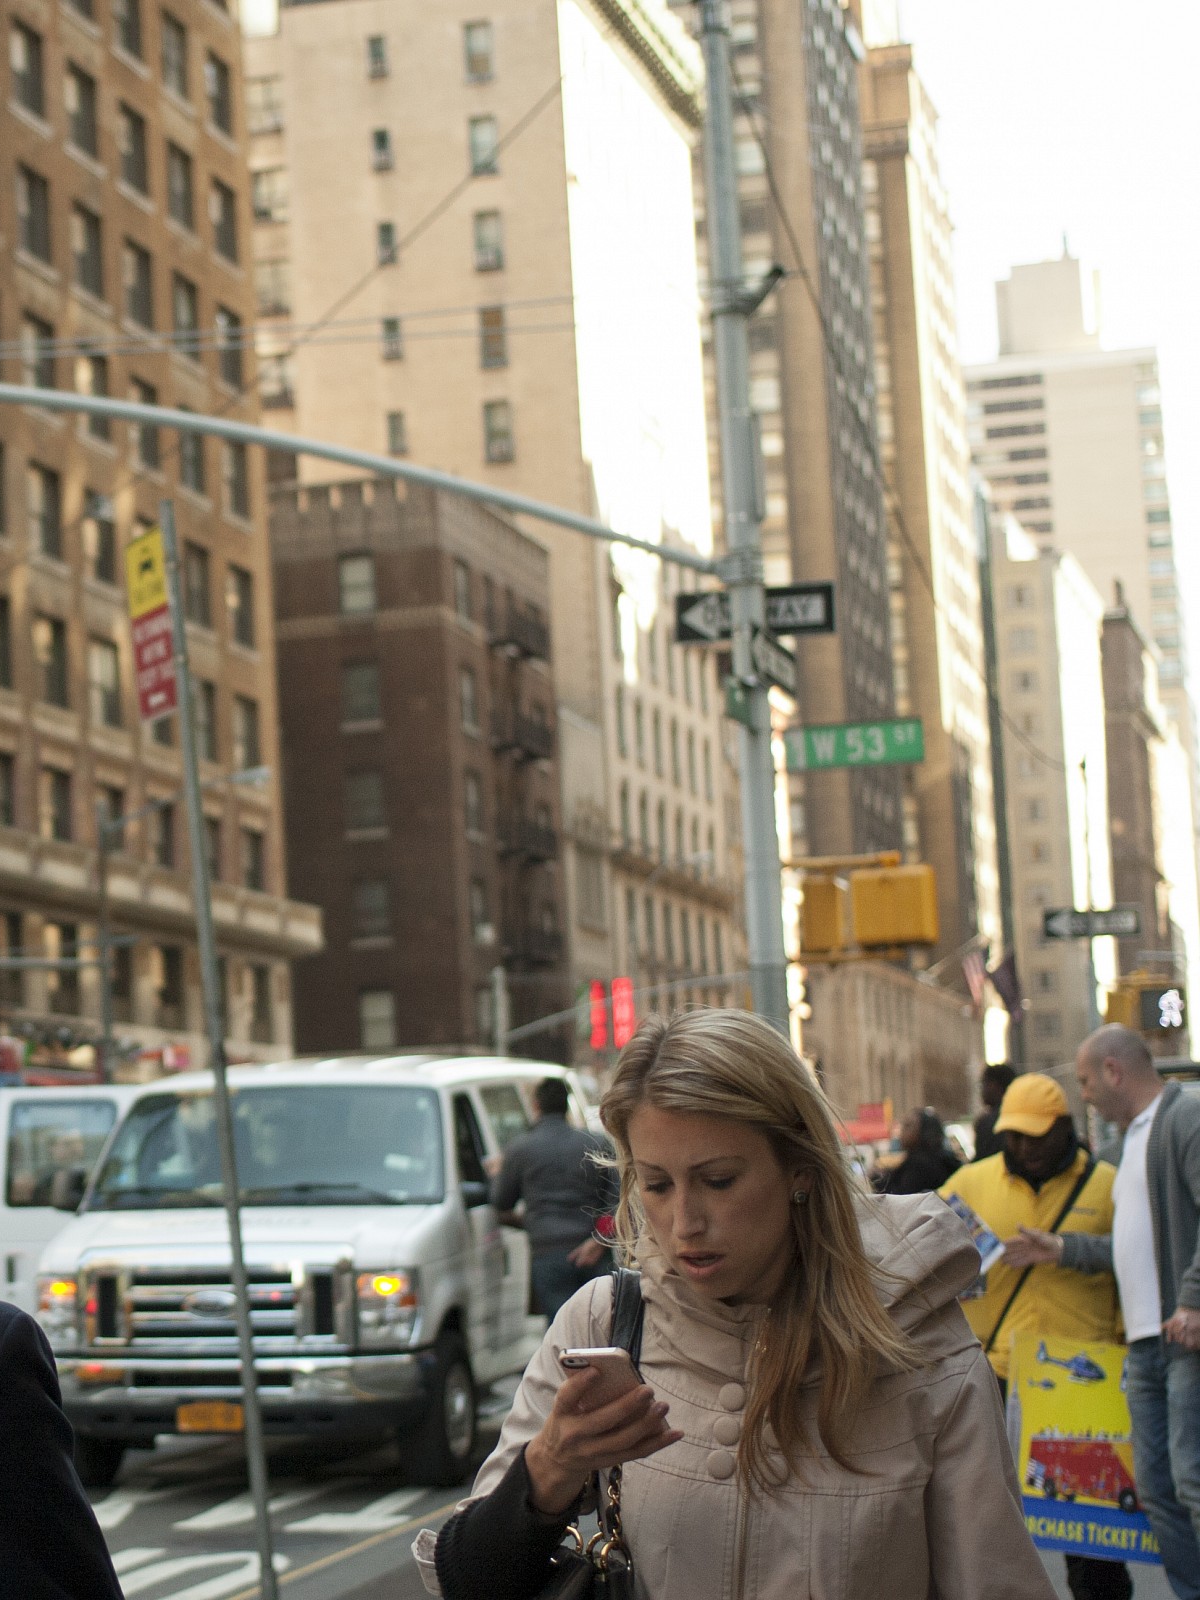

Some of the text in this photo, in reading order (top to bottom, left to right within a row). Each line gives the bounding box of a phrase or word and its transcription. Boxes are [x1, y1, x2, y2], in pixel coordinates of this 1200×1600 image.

[812, 730, 836, 763] W
[846, 727, 885, 761] 53
[1025, 1516, 1084, 1543] RCHASE
[1087, 1522, 1138, 1549] TICKET
